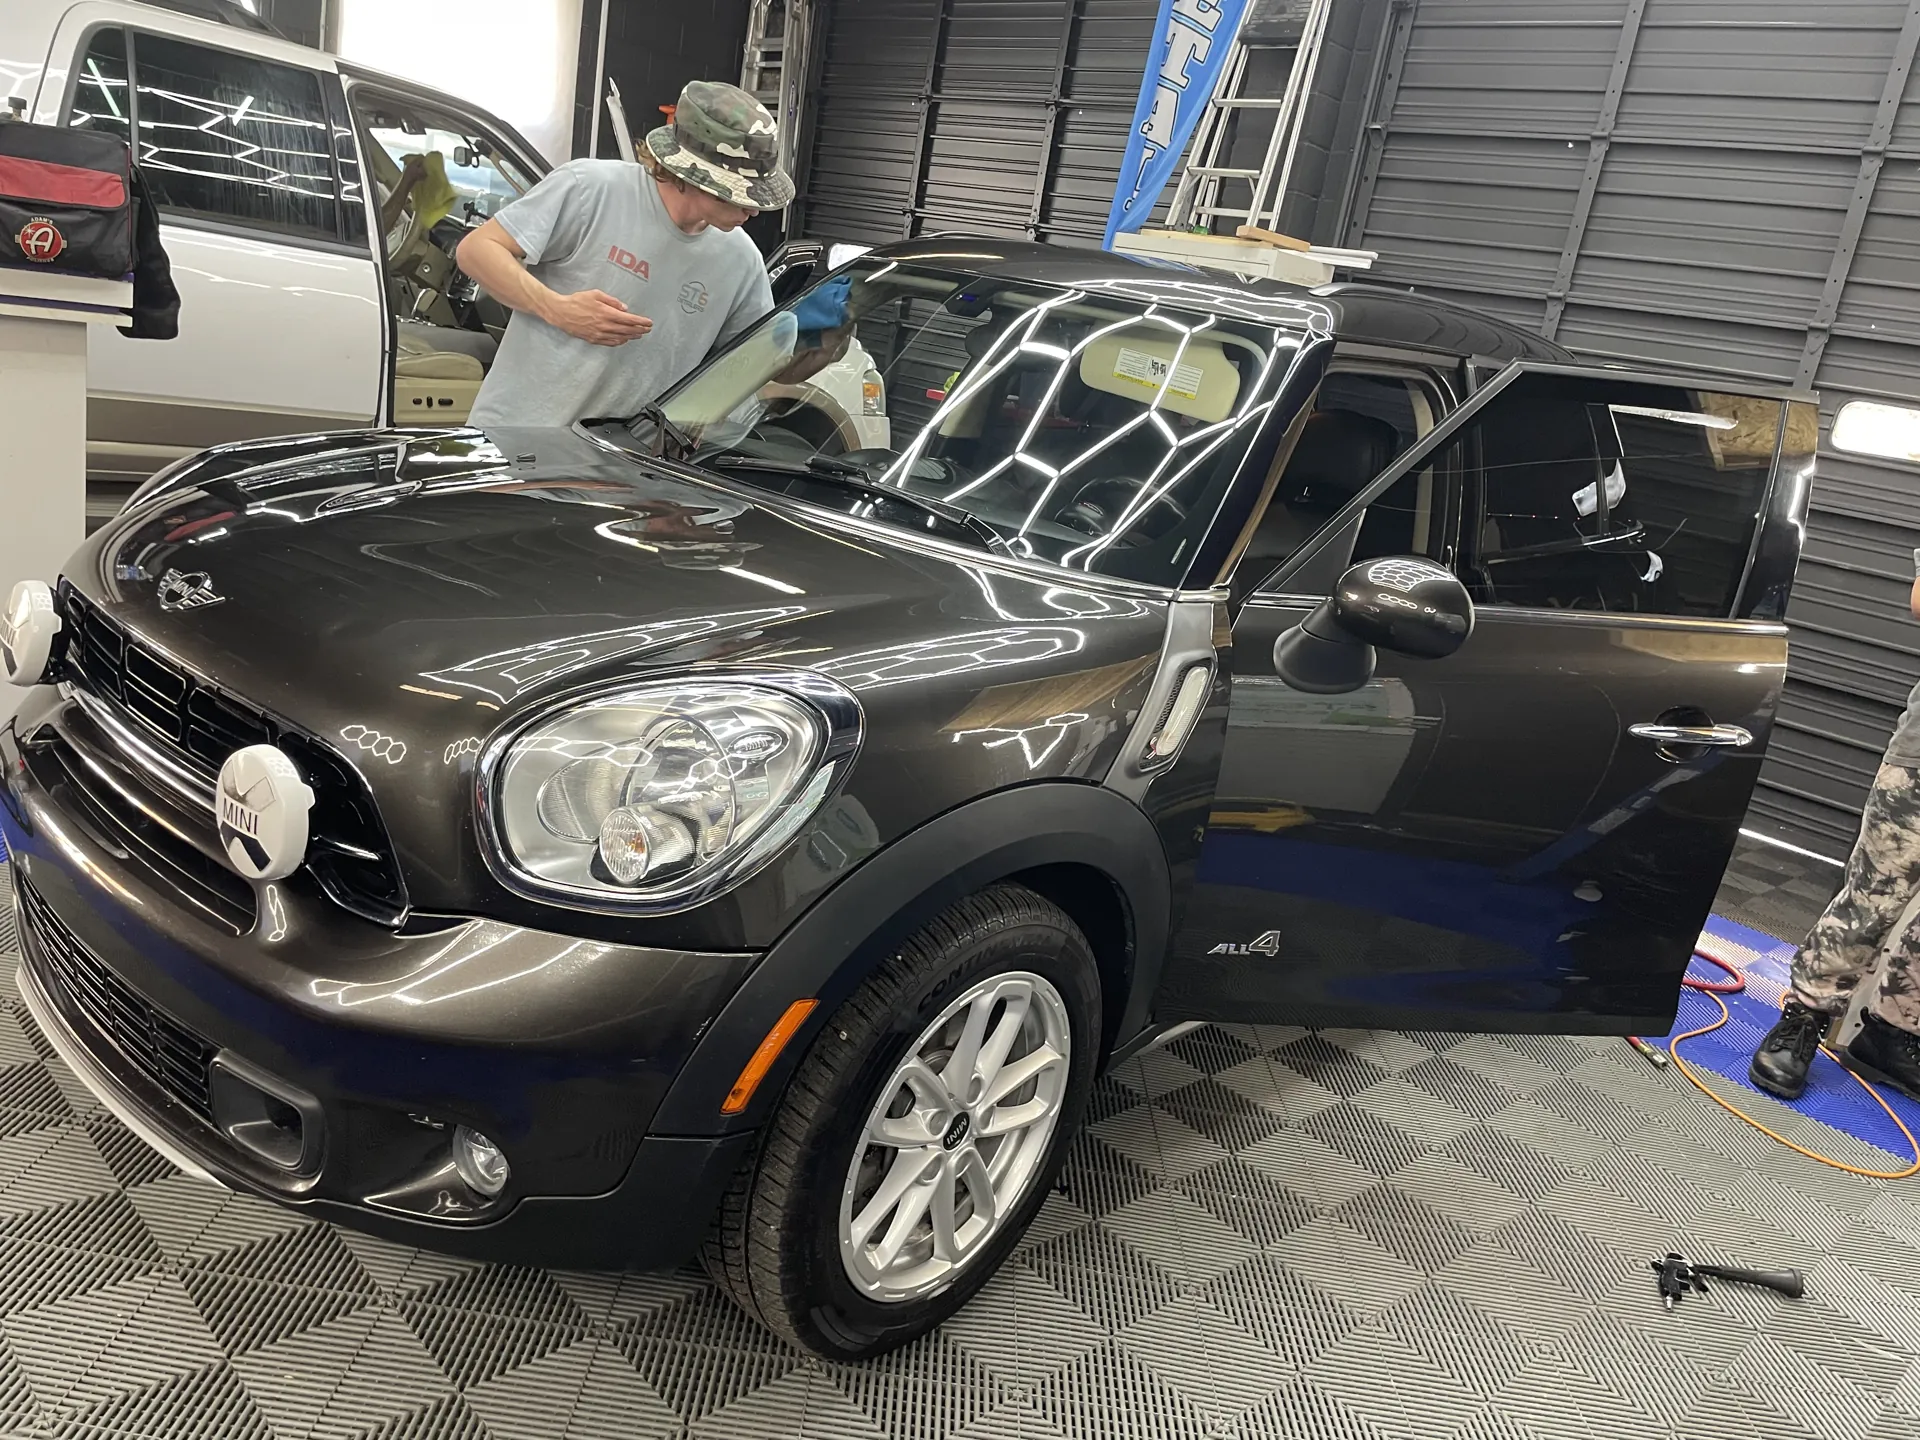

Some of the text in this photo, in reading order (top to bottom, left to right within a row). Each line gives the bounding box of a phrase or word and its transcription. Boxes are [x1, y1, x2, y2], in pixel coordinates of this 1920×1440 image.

[31, 216, 53, 225] ADAM'S
[607, 245, 650, 280] IDA
[223, 797, 258, 835] MINI
[946, 1117, 967, 1145] MINI
